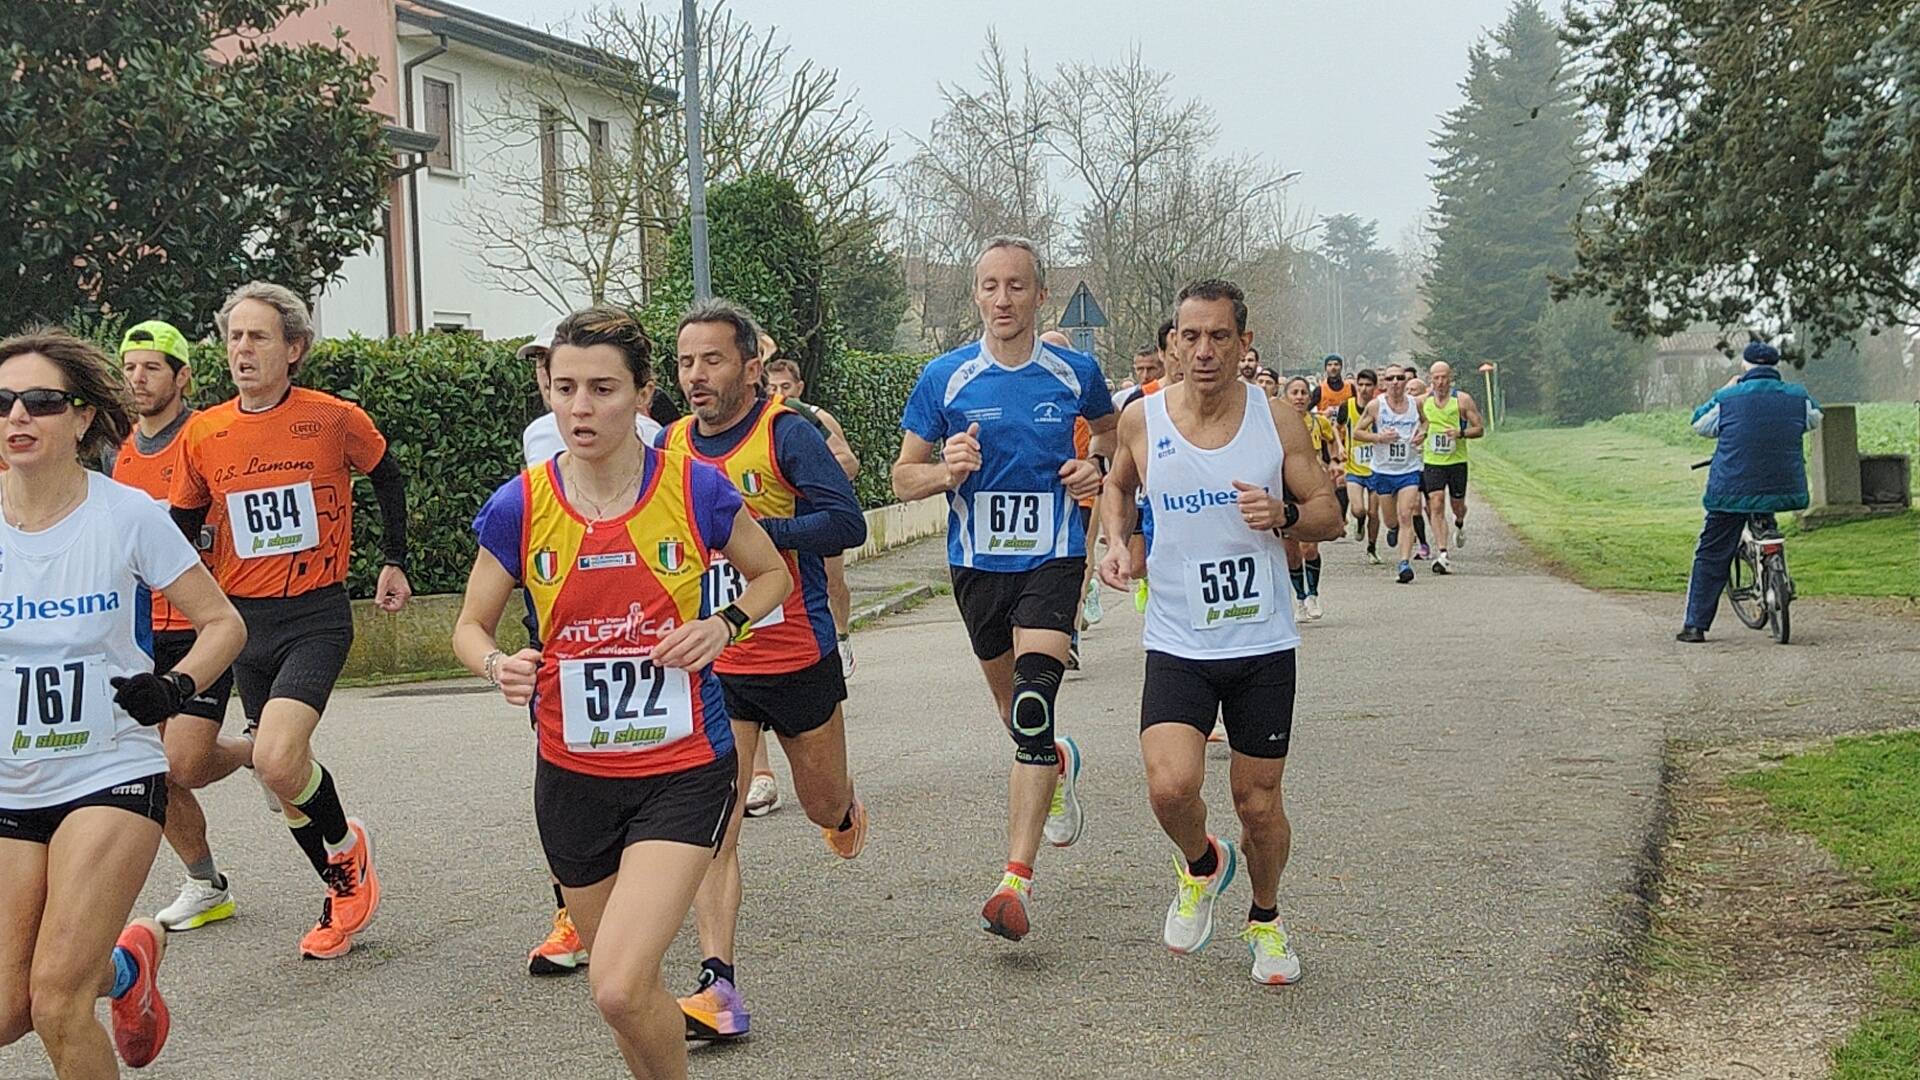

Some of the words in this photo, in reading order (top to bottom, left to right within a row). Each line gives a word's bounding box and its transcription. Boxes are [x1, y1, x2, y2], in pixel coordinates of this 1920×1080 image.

[243, 457, 315, 476] Lamone
[1389, 443, 1406, 457] 613
[244, 488, 301, 533] 634
[990, 495, 1039, 533] 673
[1163, 487, 1269, 514] lughes
[1200, 557, 1259, 604] 532
[15, 661, 84, 726] 767
[584, 660, 667, 721] 522
